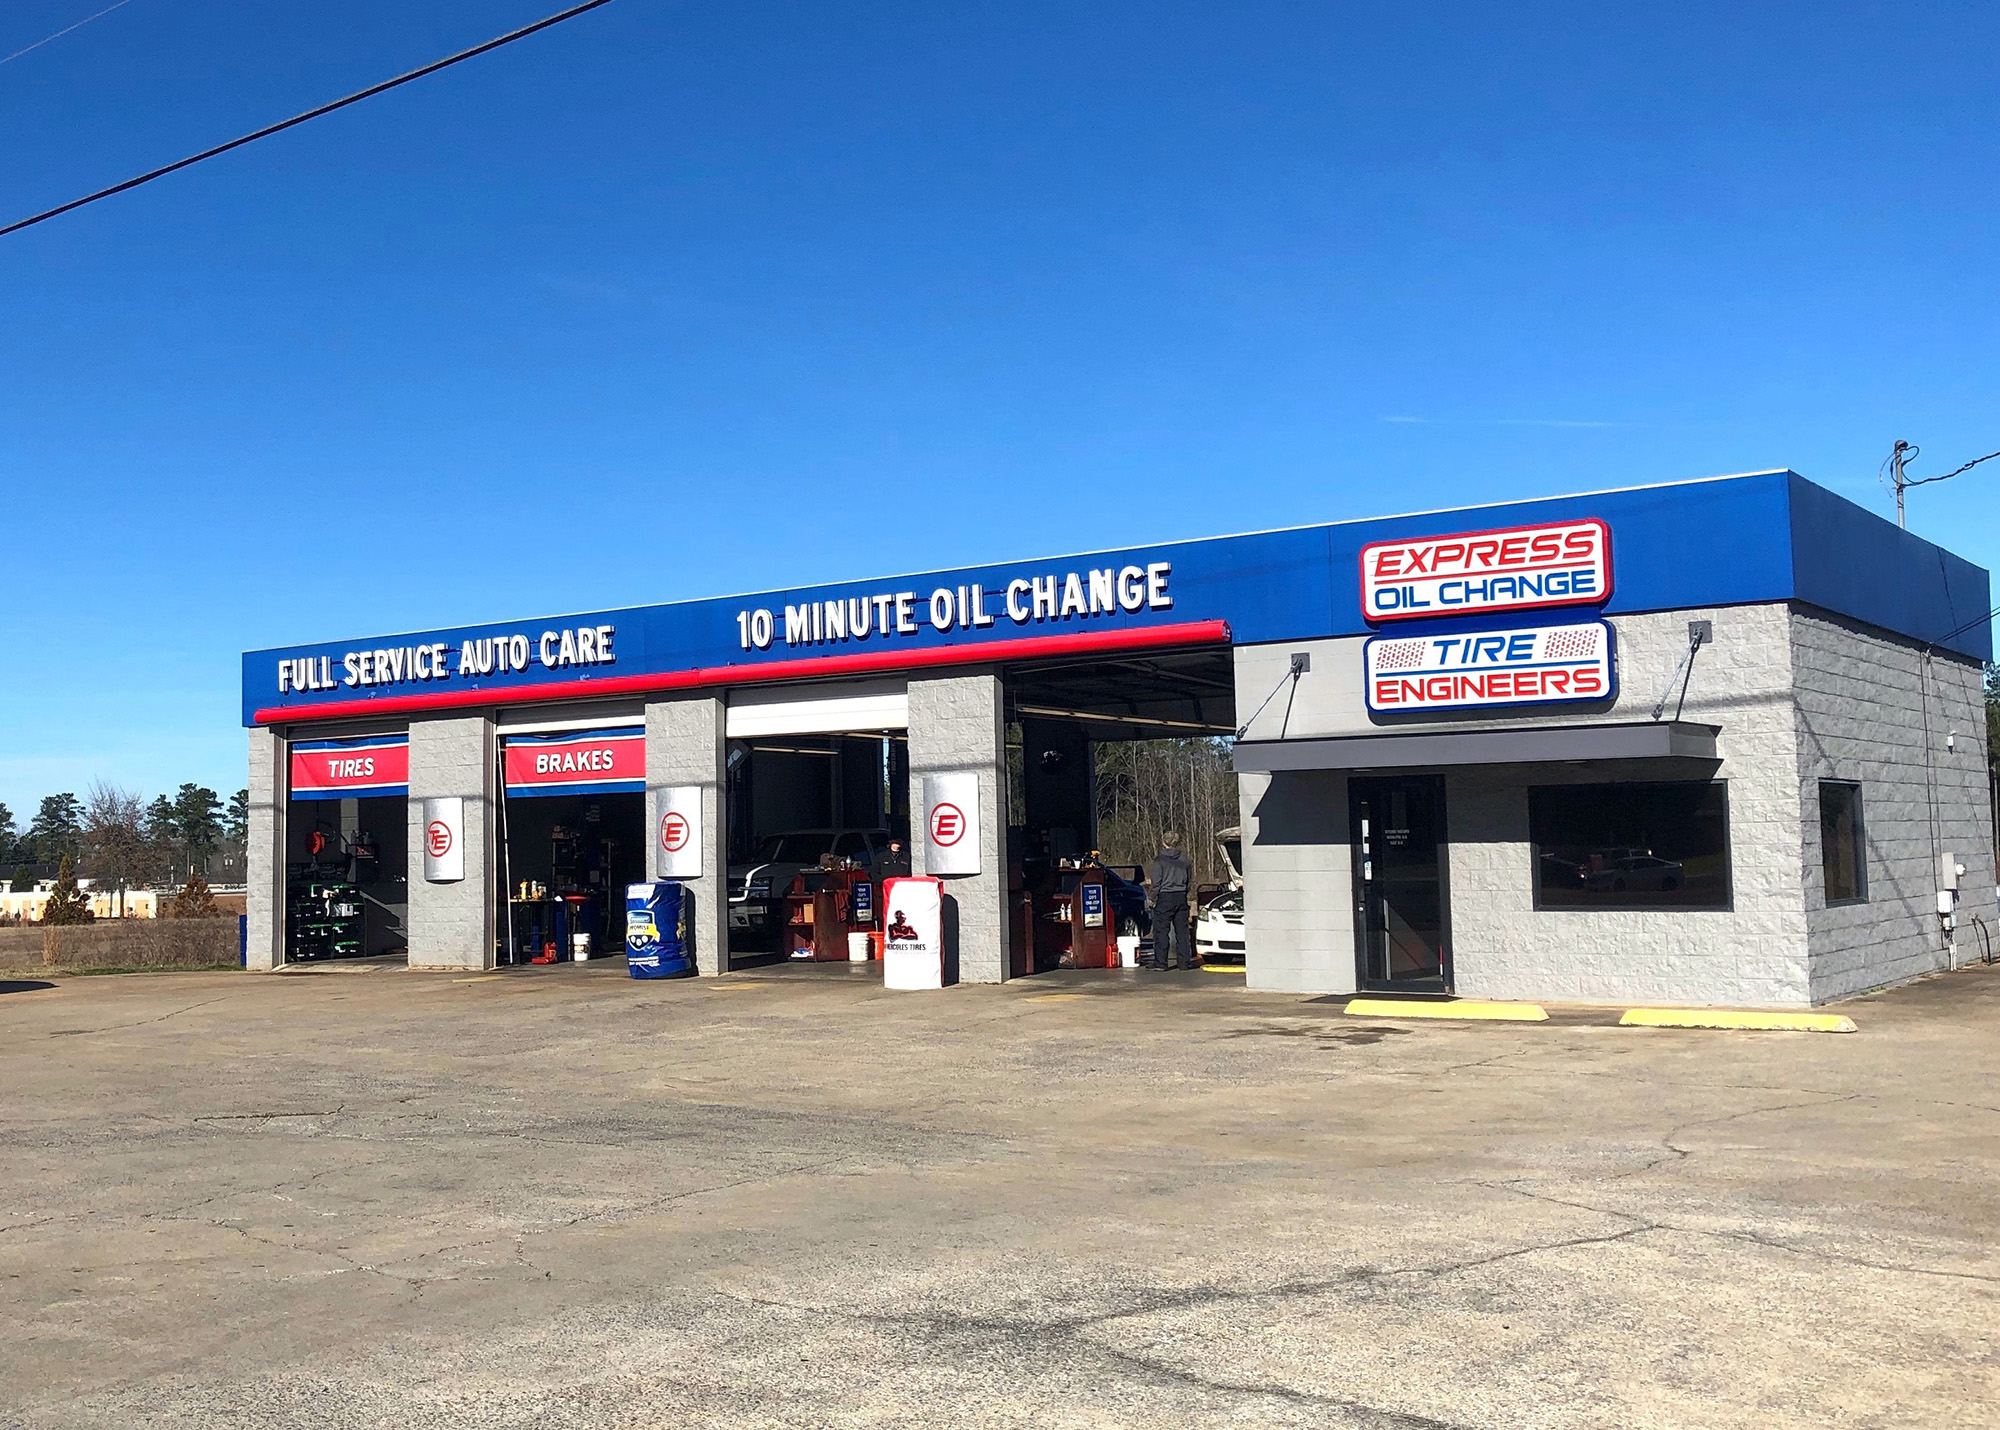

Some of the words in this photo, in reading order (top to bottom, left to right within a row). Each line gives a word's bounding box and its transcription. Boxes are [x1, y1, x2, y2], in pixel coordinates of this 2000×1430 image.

[1374, 530, 1596, 577] EXPRESS
[737, 608, 775, 649] 10
[785, 592, 917, 644] MINUTE
[930, 584, 994, 630] OIL
[1007, 562, 1173, 622] CHANGE
[1375, 586, 1430, 610] OIL
[1439, 570, 1596, 605] CHANGE
[278, 657, 337, 693] FULL
[344, 643, 449, 687] SERVICE
[459, 634, 529, 676] AUTO
[540, 625, 615, 667] CARE
[1433, 634, 1537, 665] TIRE
[1376, 668, 1601, 703] ENGINEERS
[328, 757, 375, 778] TIRES
[536, 749, 614, 774] BRAKES
